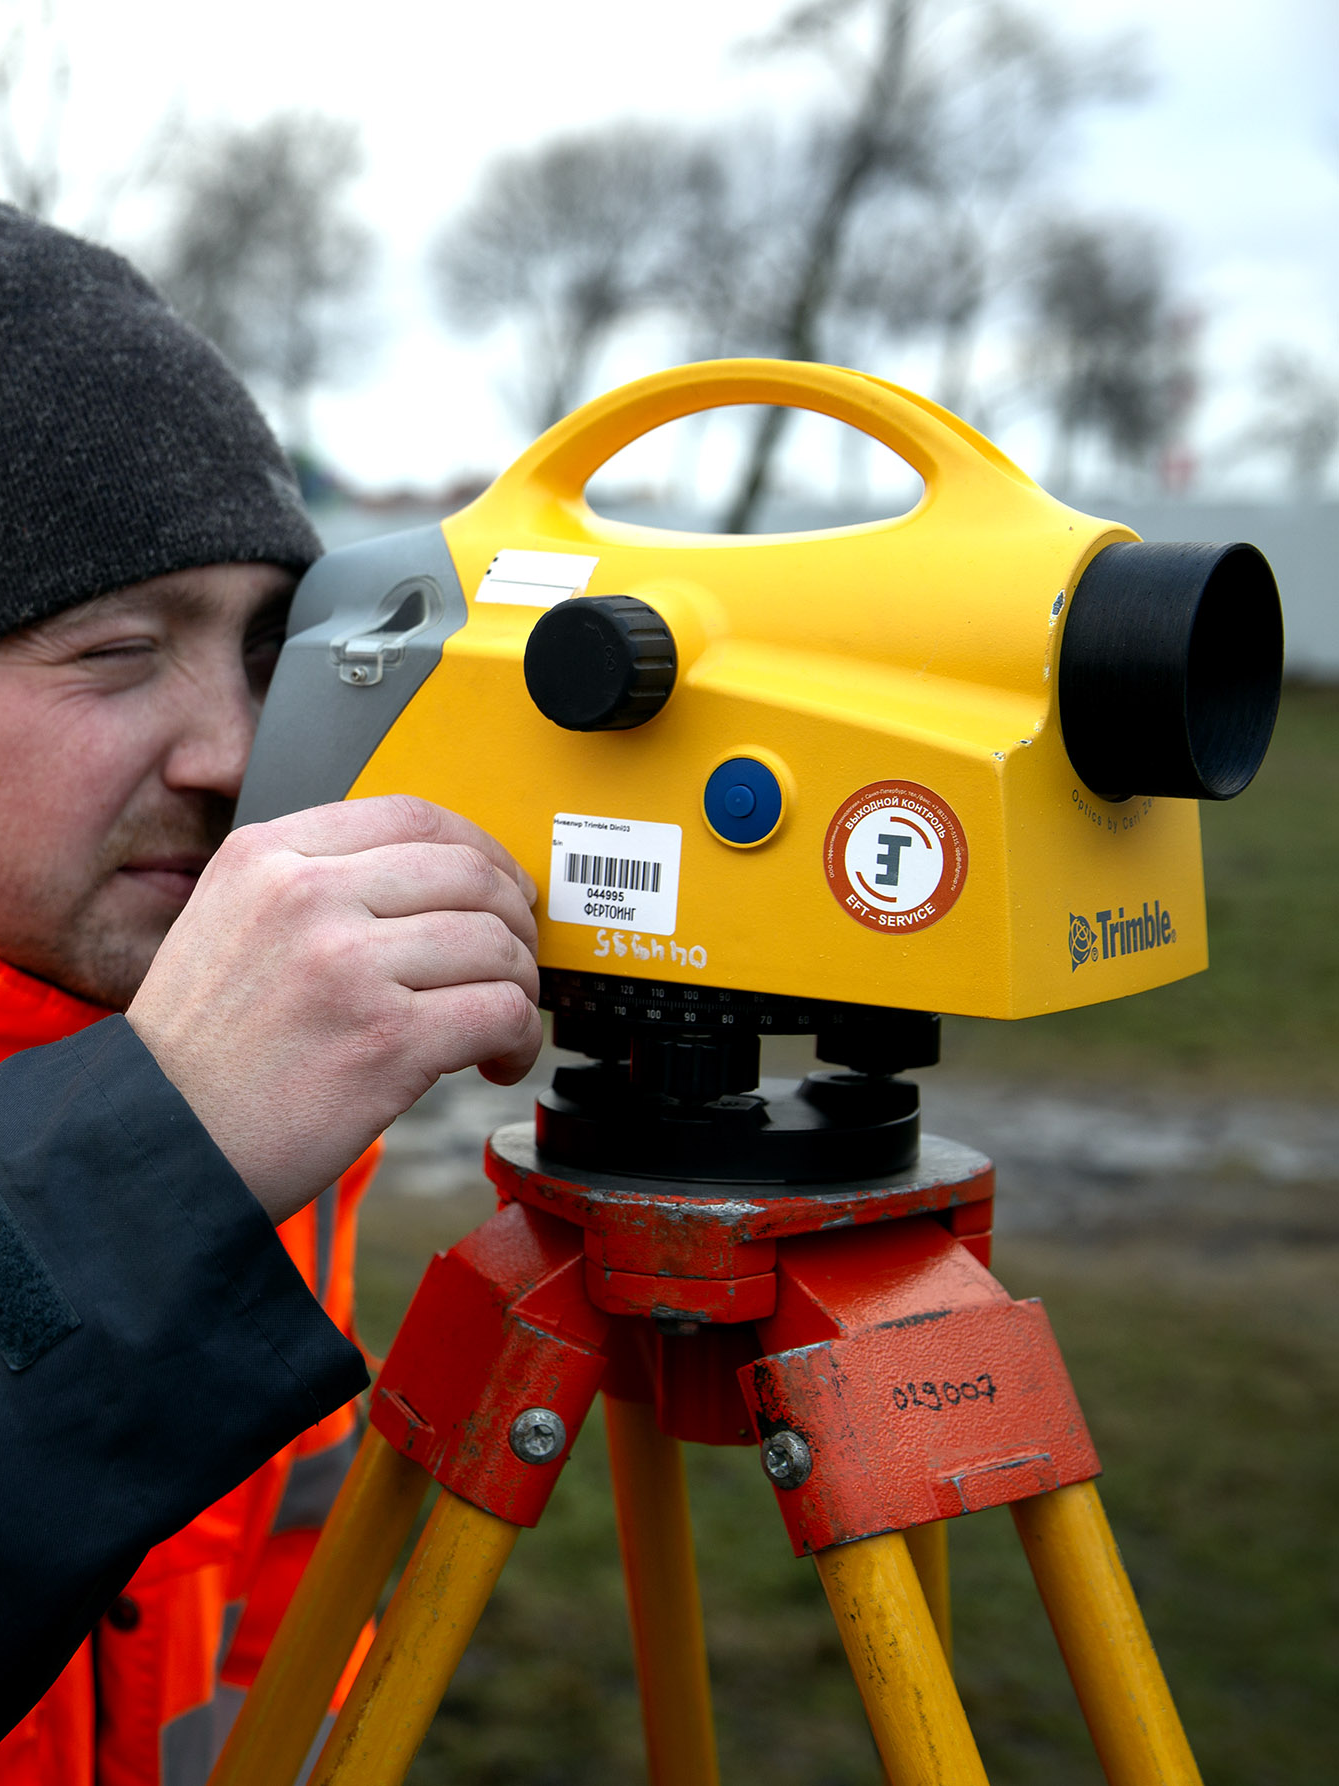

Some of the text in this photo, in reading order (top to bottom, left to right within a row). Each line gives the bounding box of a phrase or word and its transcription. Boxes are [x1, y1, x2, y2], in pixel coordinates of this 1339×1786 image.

[844, 795, 946, 839] ВЫХОДНОЙ КОНТРОЛЬ
[1072, 789, 1102, 826] Optics
[1107, 817, 1118, 834] by
[1122, 811, 1141, 830] Carl
[584, 821, 608, 830] Trimble
[587, 887, 625, 902] 044995
[583, 902, 637, 921] ФЕРТОИНГ
[845, 893, 870, 917] EFT
[878, 902, 936, 927] SERVICE
[1096, 900, 1172, 960] Trimble
[620, 985, 634, 995] 120
[651, 988, 665, 998] 110
[683, 990, 699, 1000] 100
[614, 1006, 627, 1016] 110
[646, 1009, 661, 1020] 100
[684, 1012, 696, 1022] 90
[722, 1014, 734, 1024] 80
[760, 1015, 773, 1025] 70
